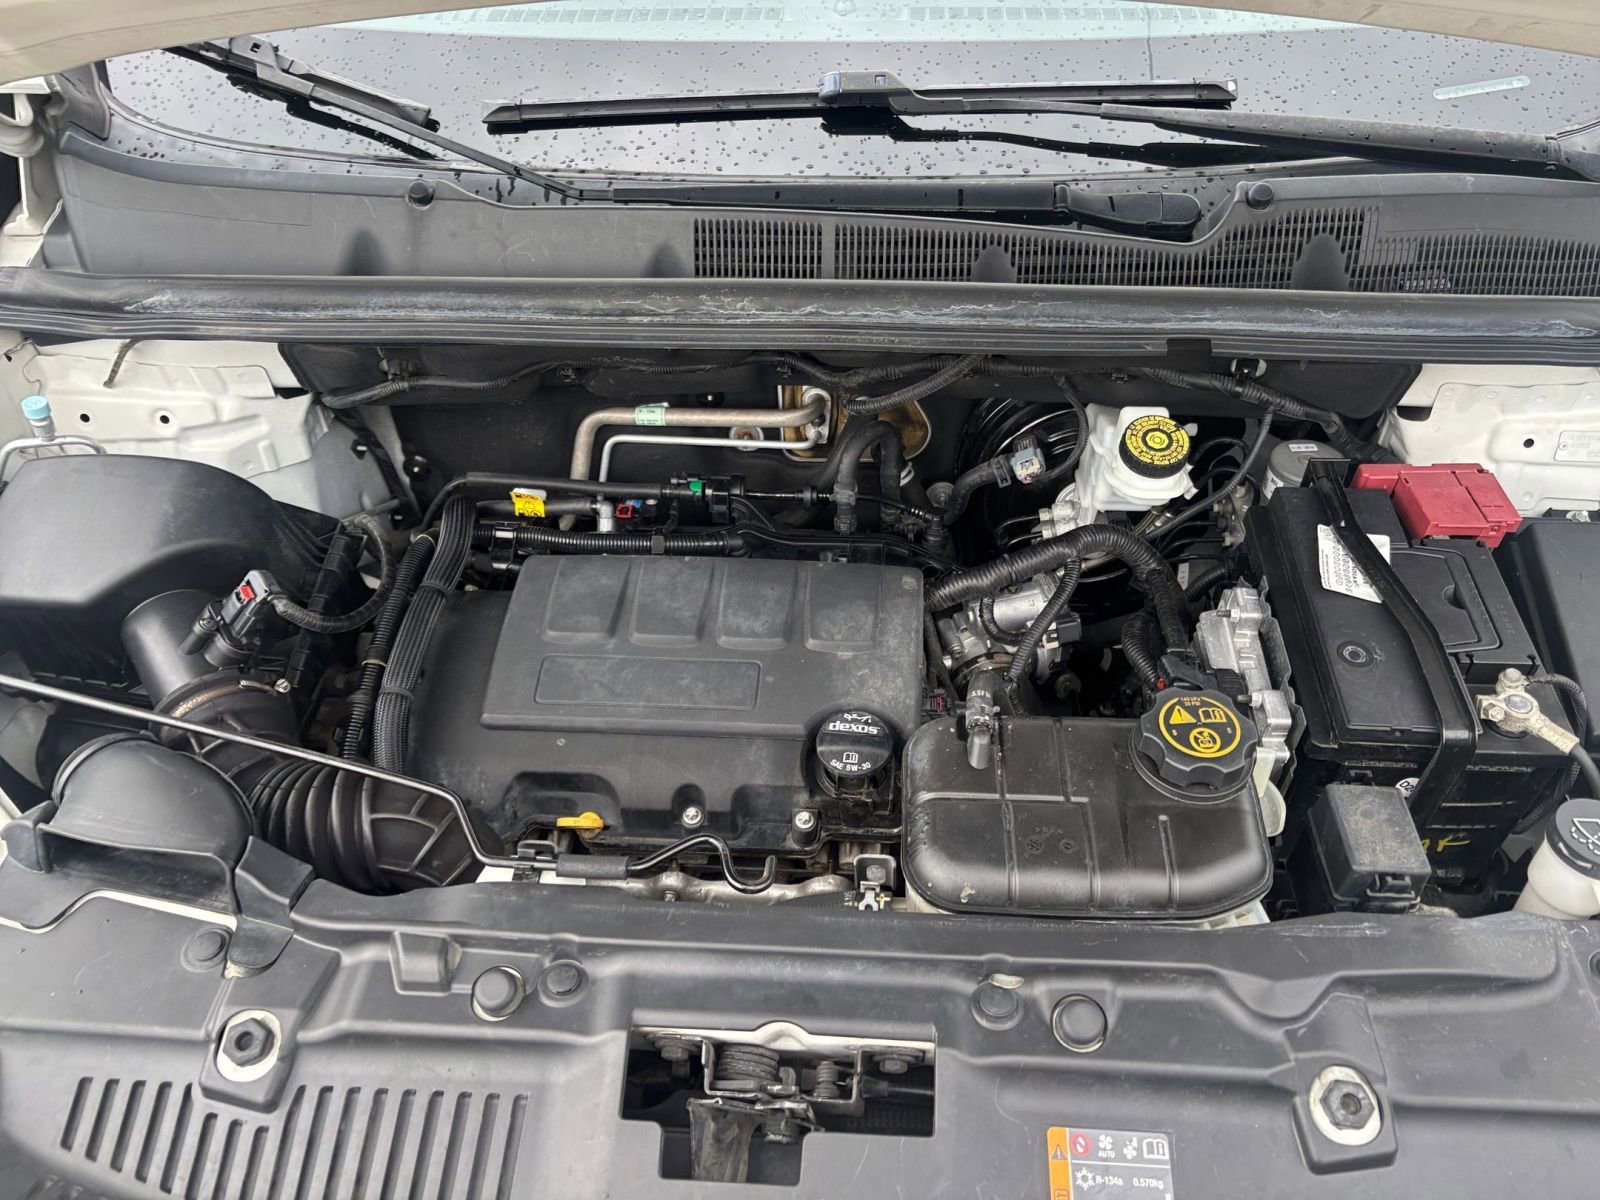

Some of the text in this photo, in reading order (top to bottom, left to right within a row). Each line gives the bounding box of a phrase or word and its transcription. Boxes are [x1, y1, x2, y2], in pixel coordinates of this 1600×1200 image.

[828, 720, 880, 735] dexos
[830, 759, 871, 772] SAE 5W-30
[1097, 1150, 1115, 1159] AUTO
[1095, 1174, 1164, 1190] R-134a 0.570kg
